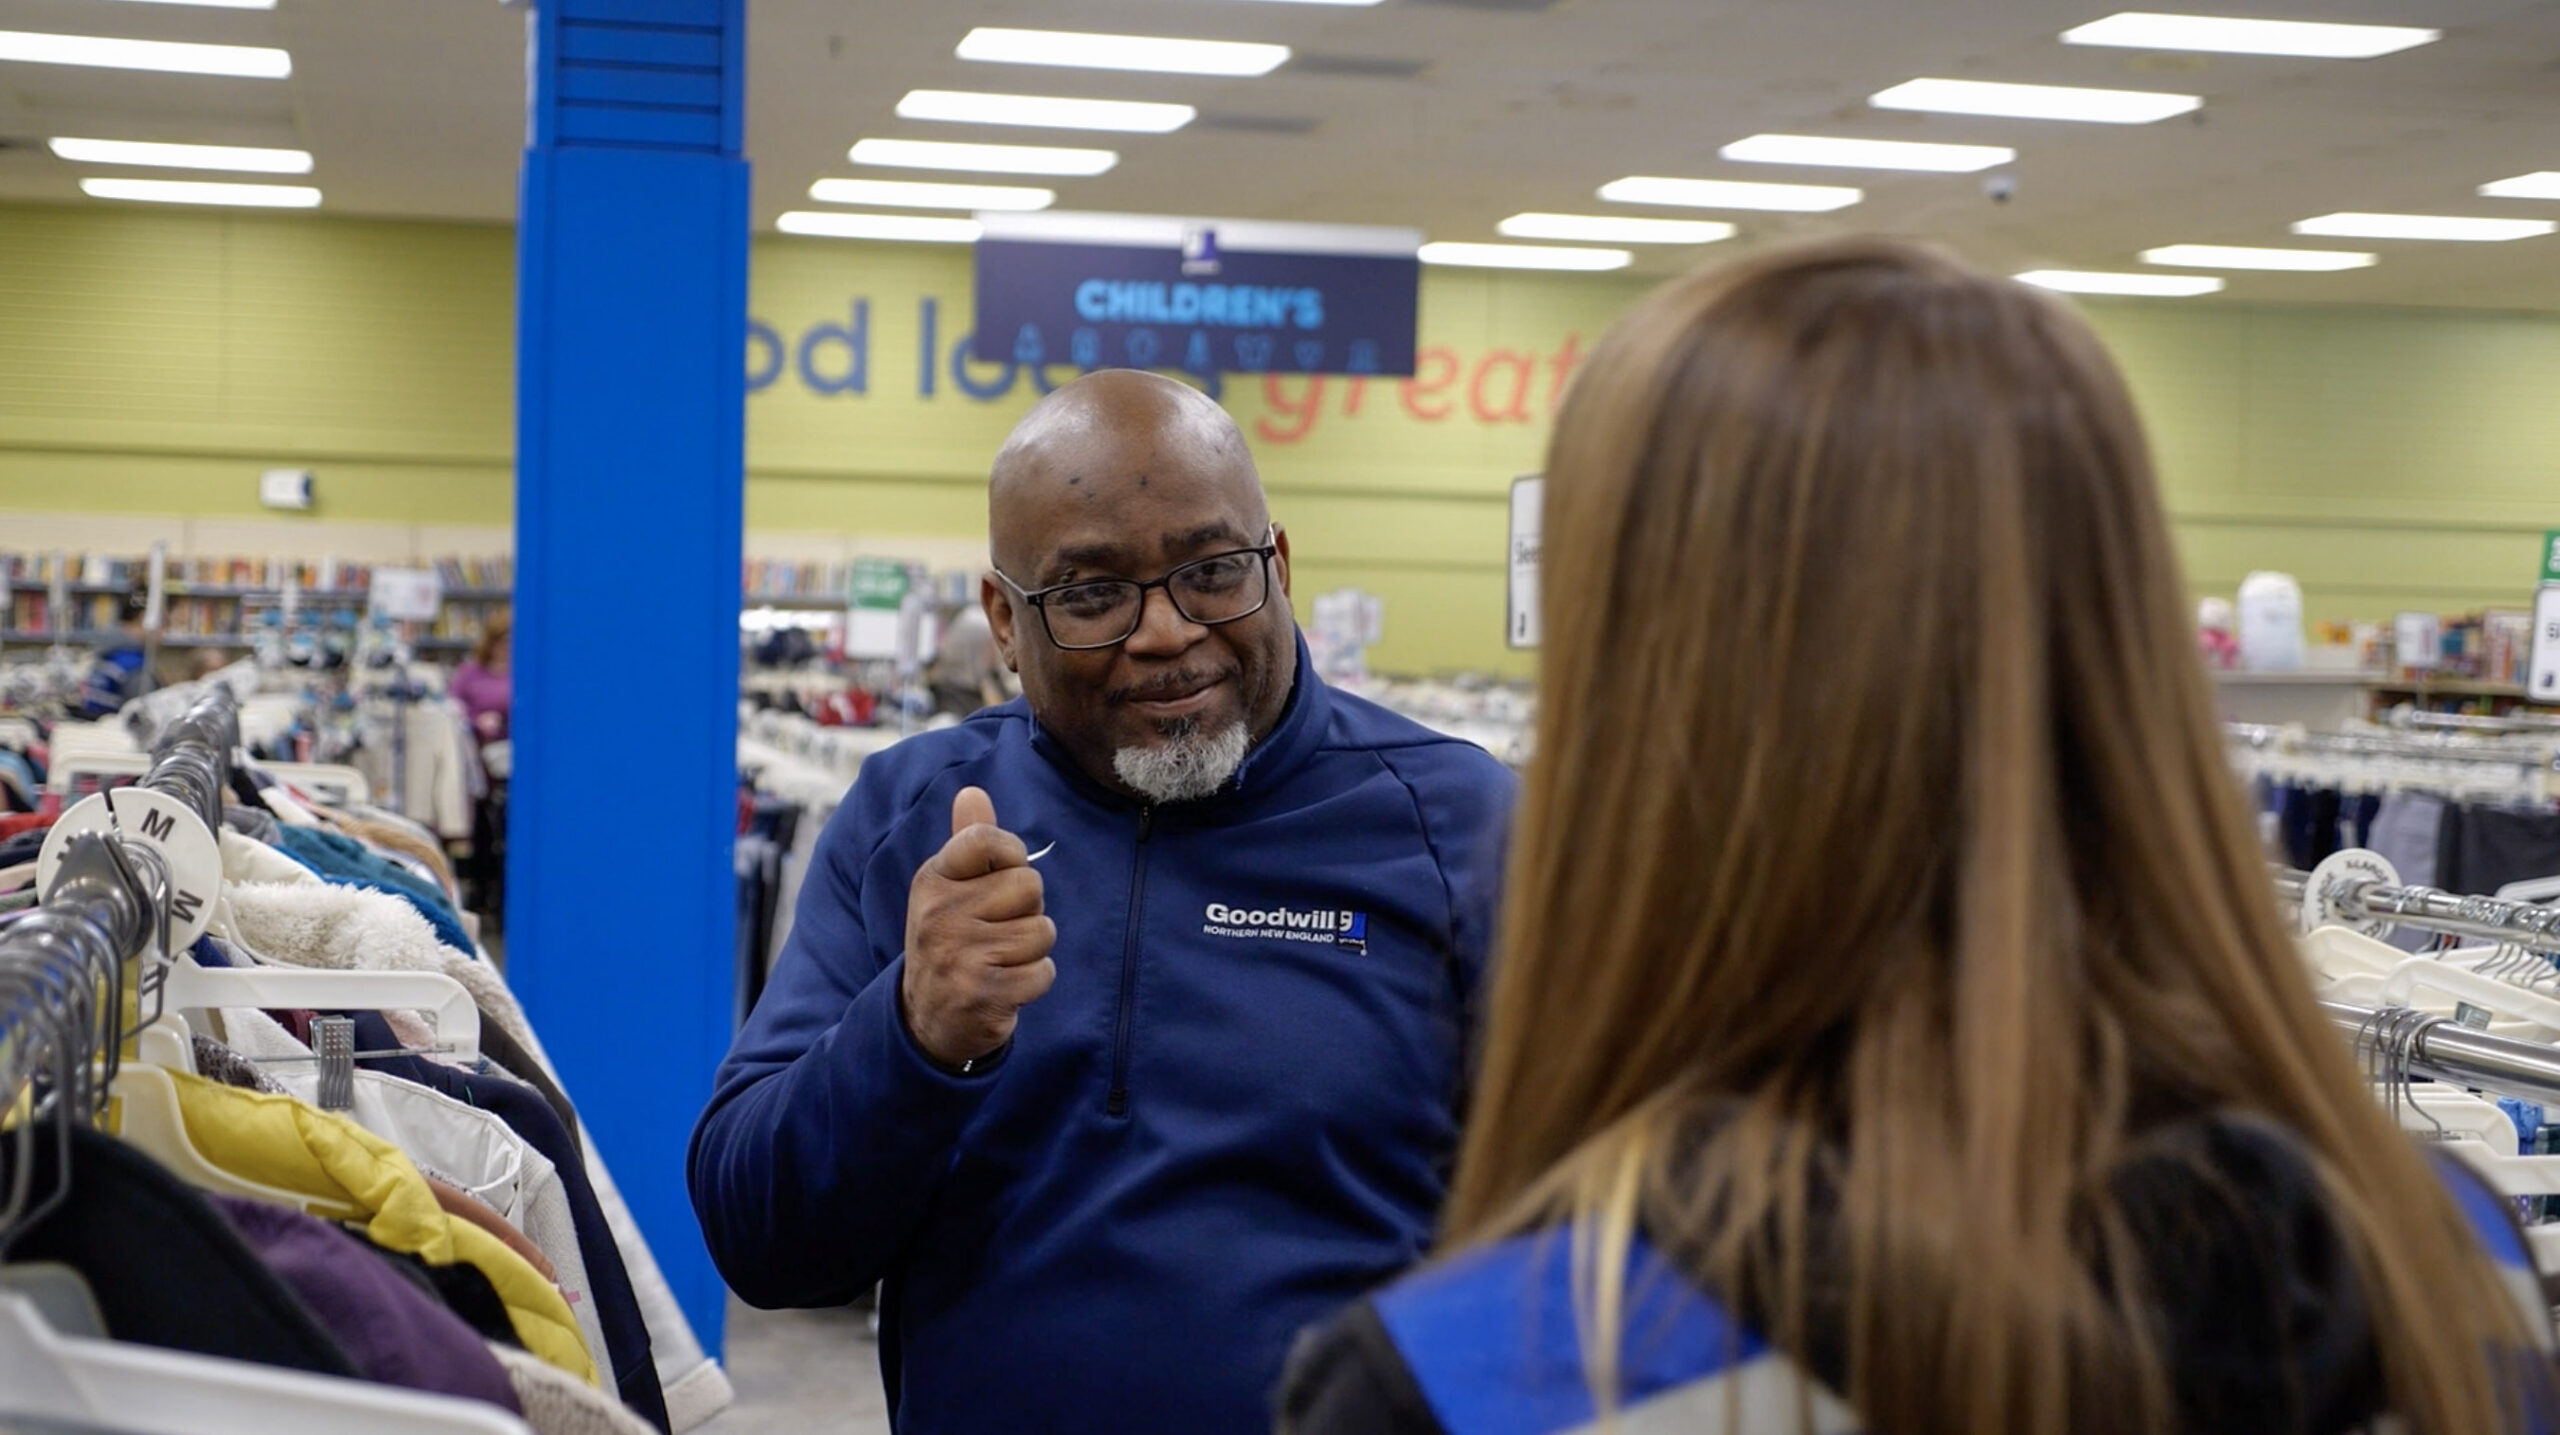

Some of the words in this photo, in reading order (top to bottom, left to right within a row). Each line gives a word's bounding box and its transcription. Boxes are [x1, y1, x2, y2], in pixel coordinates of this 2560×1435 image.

[1075, 278, 1324, 329] CHILDREN'S
[141, 808, 176, 842] M
[170, 889, 204, 924] M
[1205, 902, 1336, 929] Goodwill
[1203, 924, 1258, 938] NORTHERN
[1259, 928, 1285, 939] NEW
[1285, 930, 1335, 943] ENGLAND
